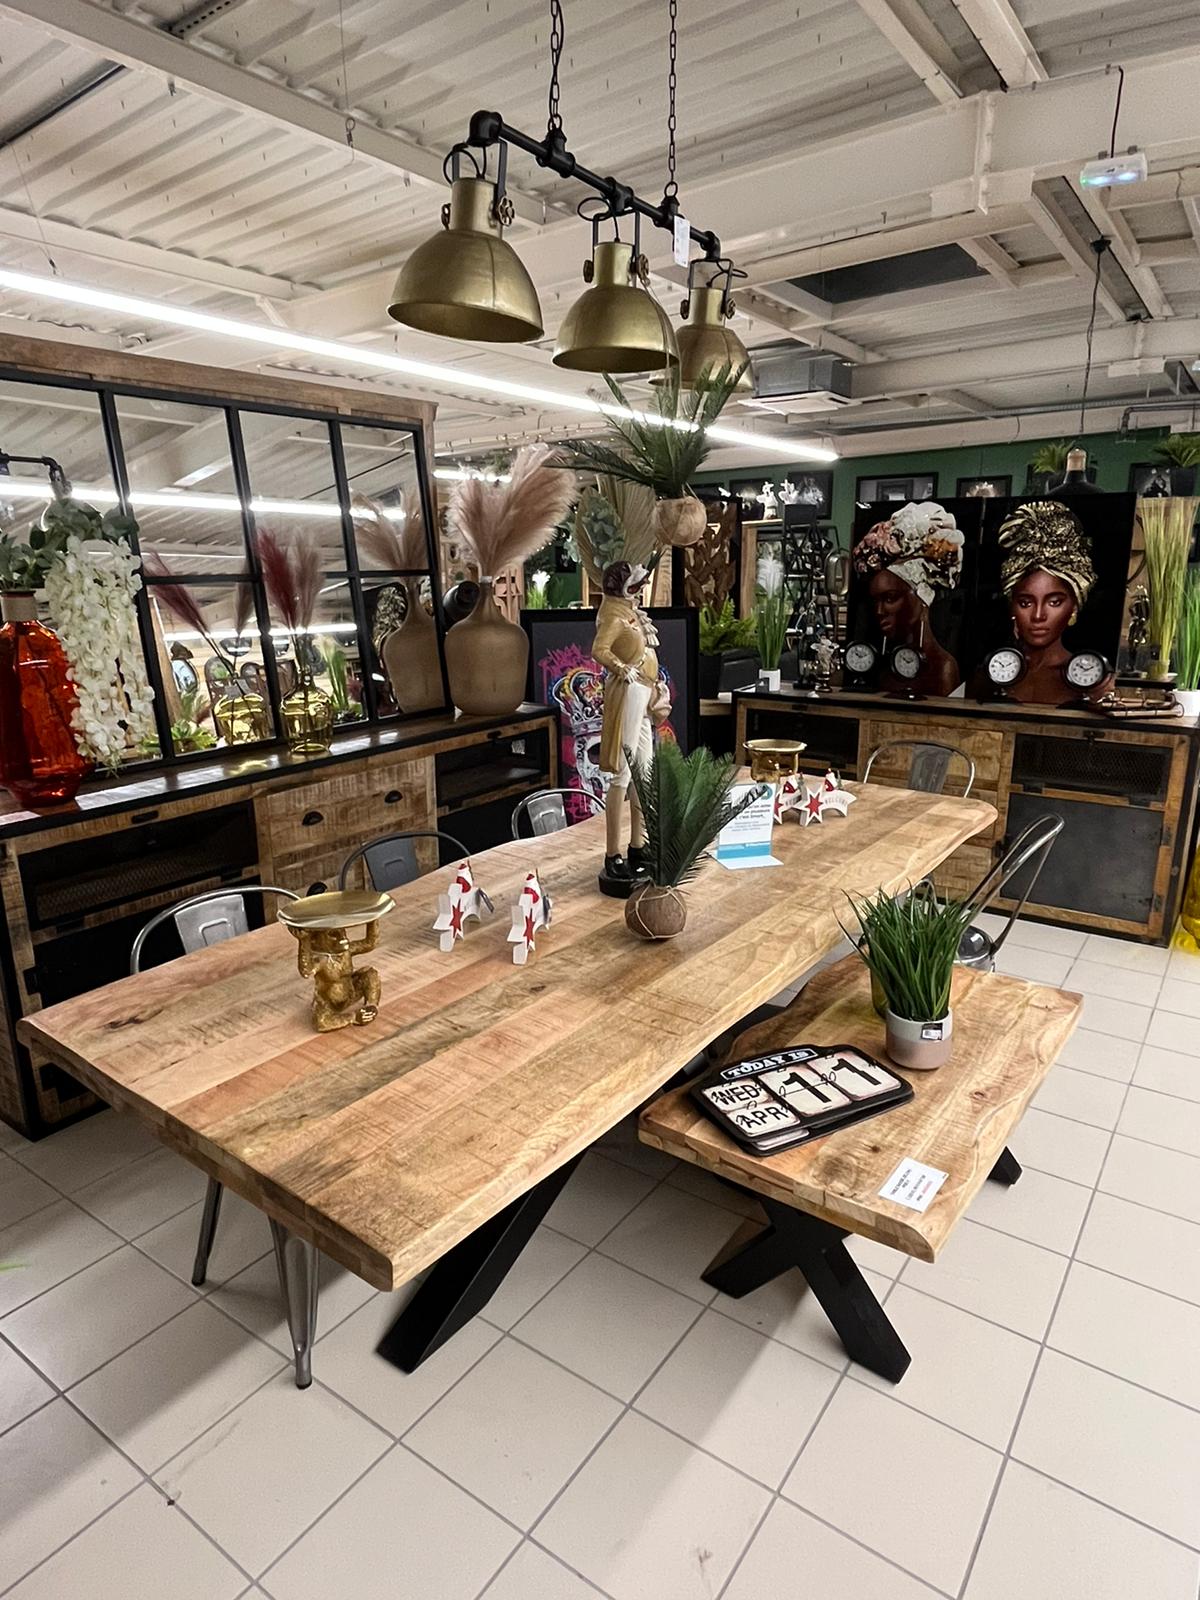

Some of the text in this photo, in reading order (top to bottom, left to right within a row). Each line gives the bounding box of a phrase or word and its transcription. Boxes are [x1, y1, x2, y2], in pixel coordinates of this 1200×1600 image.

[728, 1050, 810, 1077] TODAY IS
[717, 1085, 761, 1106] WED
[739, 1106, 788, 1129] APR
